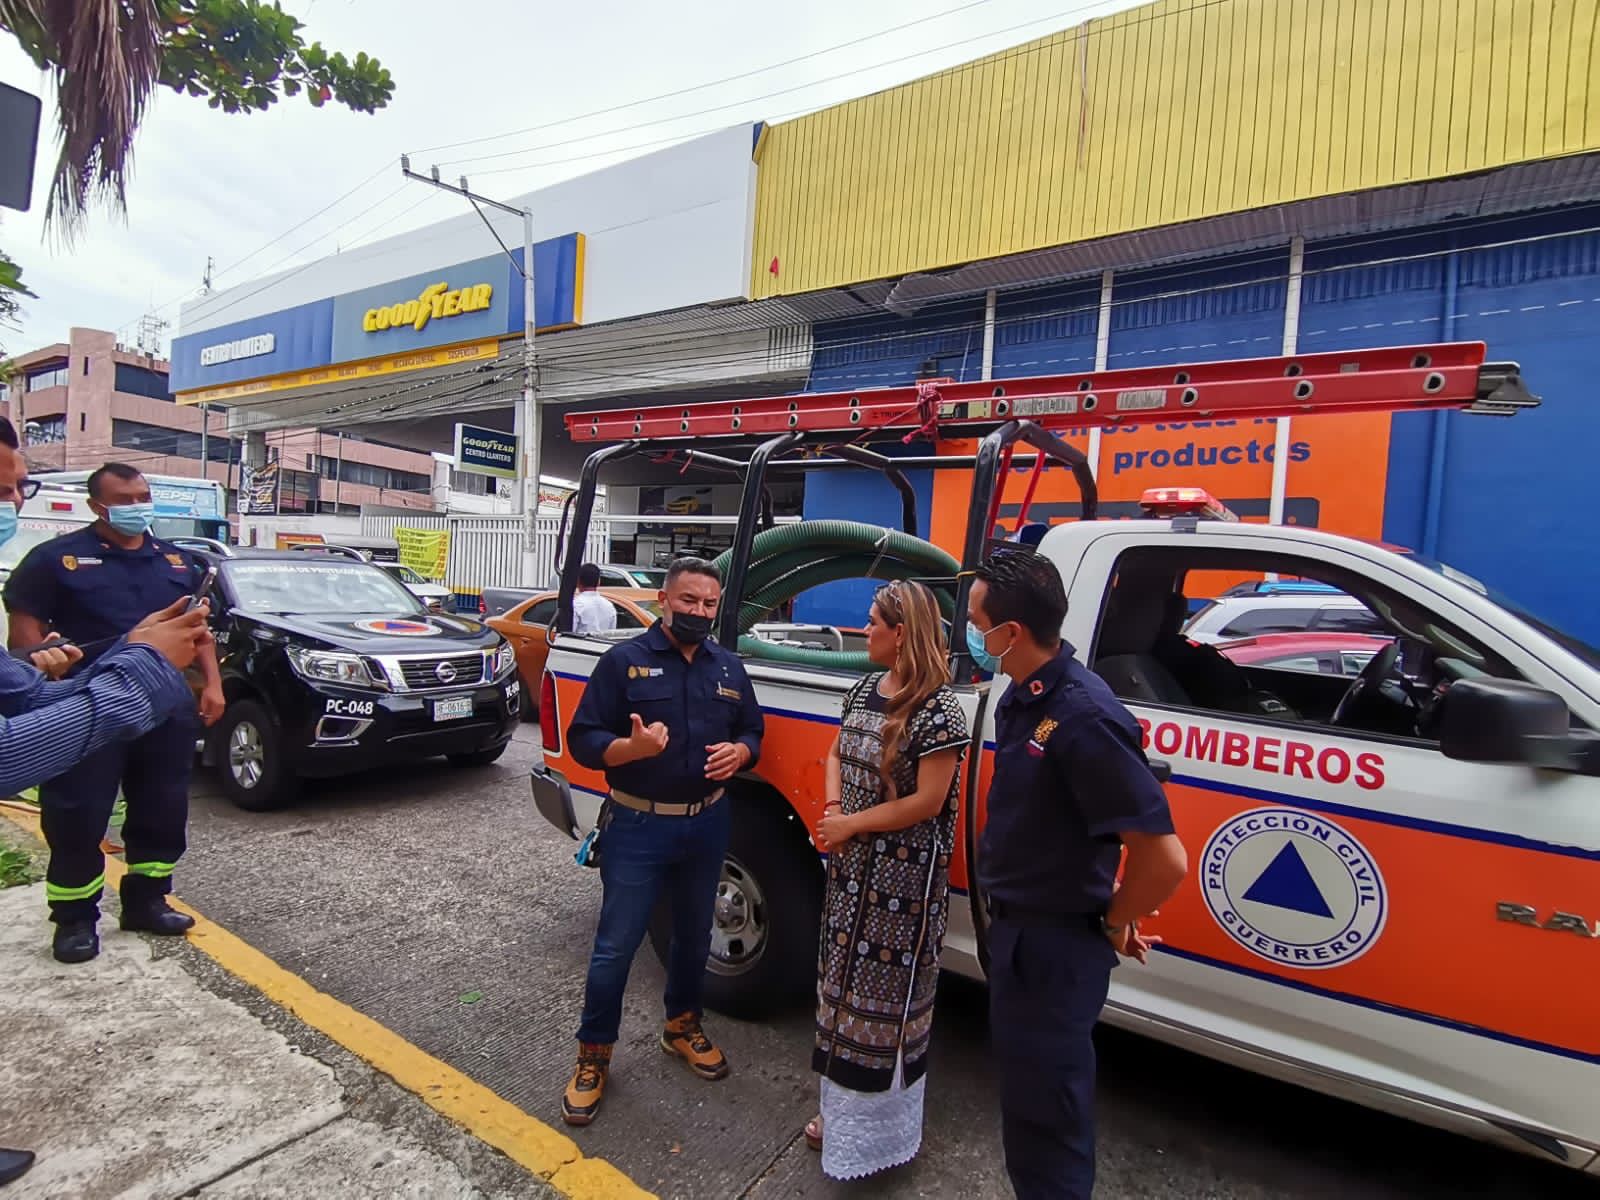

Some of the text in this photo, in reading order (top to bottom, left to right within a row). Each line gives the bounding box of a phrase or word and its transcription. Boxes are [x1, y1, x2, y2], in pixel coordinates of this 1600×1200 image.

[363, 281, 492, 332] GOODYEAR
[463, 437, 514, 453] GOODYEAR
[465, 447, 511, 463] CENTRO LLANTERO
[326, 699, 374, 715] PC-048
[1208, 816, 1376, 906] PROTECCIÓN CIVIL
[1222, 909, 1362, 961] GUERRERO
[1496, 899, 1600, 938] RA
